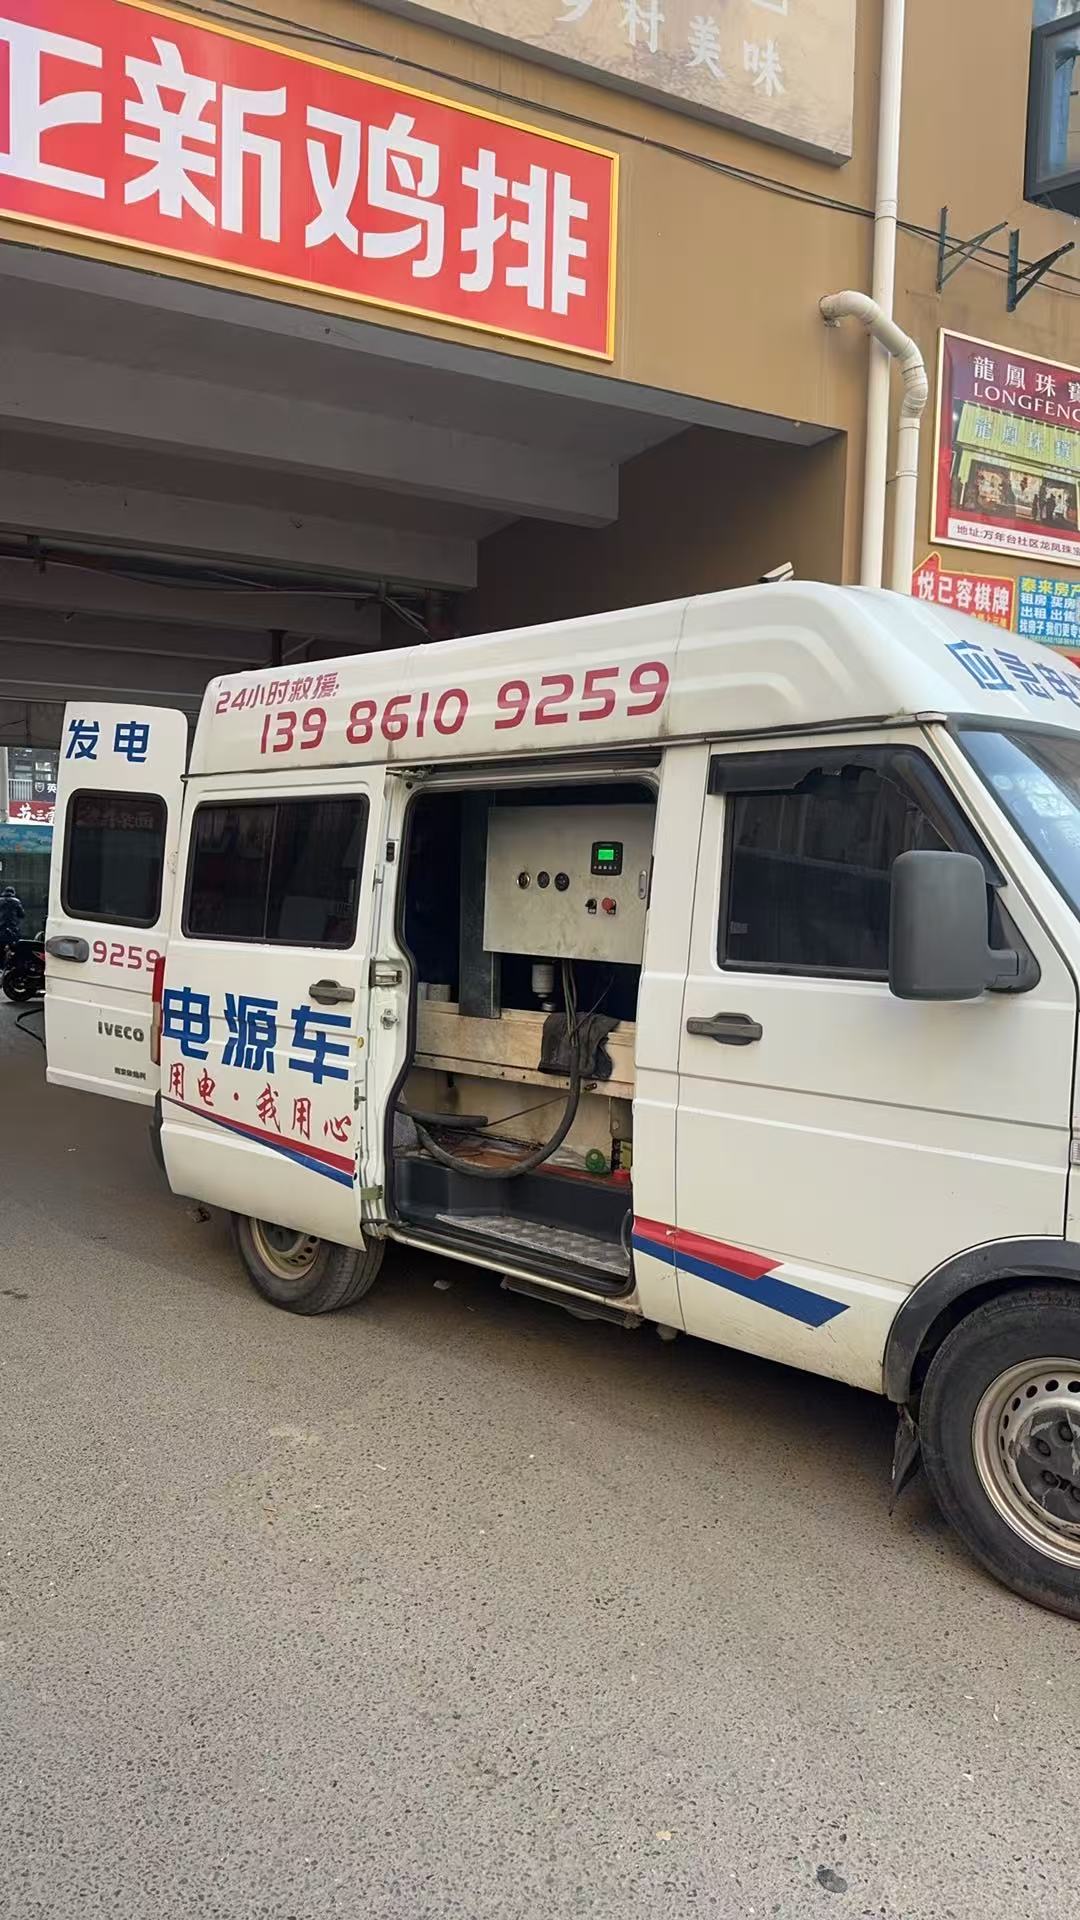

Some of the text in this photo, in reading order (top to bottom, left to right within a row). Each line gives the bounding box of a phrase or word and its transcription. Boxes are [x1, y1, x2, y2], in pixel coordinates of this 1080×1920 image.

[553, 0, 786, 97] 村美味
[0, 18, 588, 315] 正新鸡排
[65, 719, 150, 763] 发电
[260, 661, 669, 754] 139 8610 9259
[93, 940, 160, 972] 9259
[98, 1021, 145, 1042] IVECO
[163, 986, 352, 1085] 电源车
